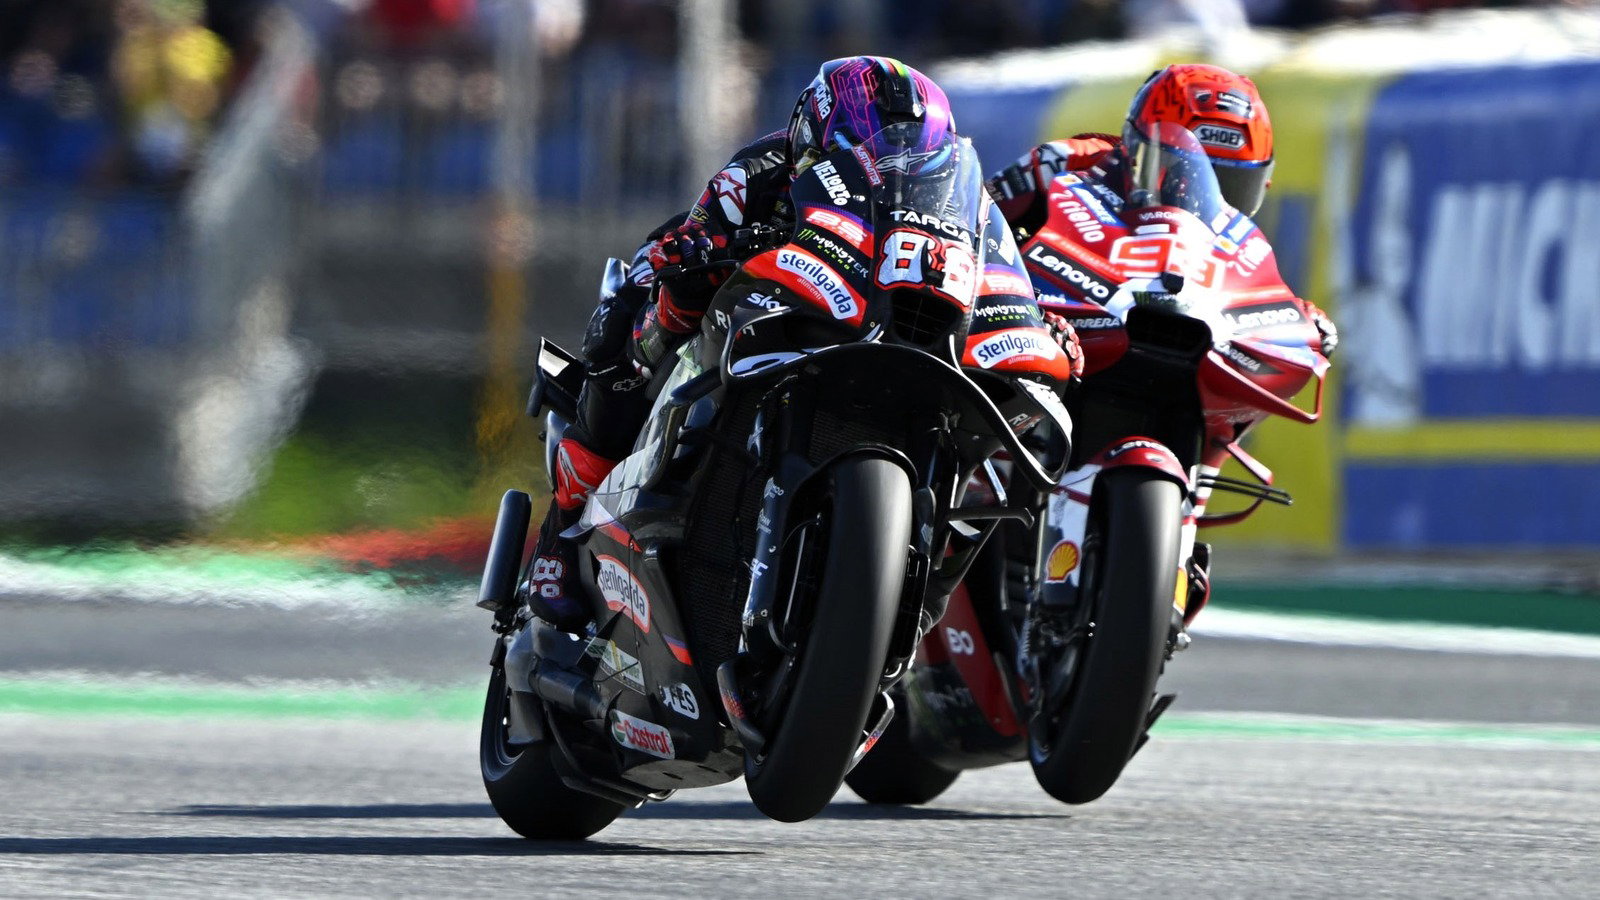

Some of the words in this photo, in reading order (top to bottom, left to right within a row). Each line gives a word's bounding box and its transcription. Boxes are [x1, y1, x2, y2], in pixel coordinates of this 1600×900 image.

[1199, 127, 1240, 145] SHOEI
[812, 234, 869, 279] MONSTER
[1028, 245, 1110, 299] Lenovo
[780, 251, 853, 315] sterilgarda
[975, 304, 1030, 317] MONSTER
[598, 562, 646, 617] sterilgarda
[624, 719, 671, 755] Castrol
